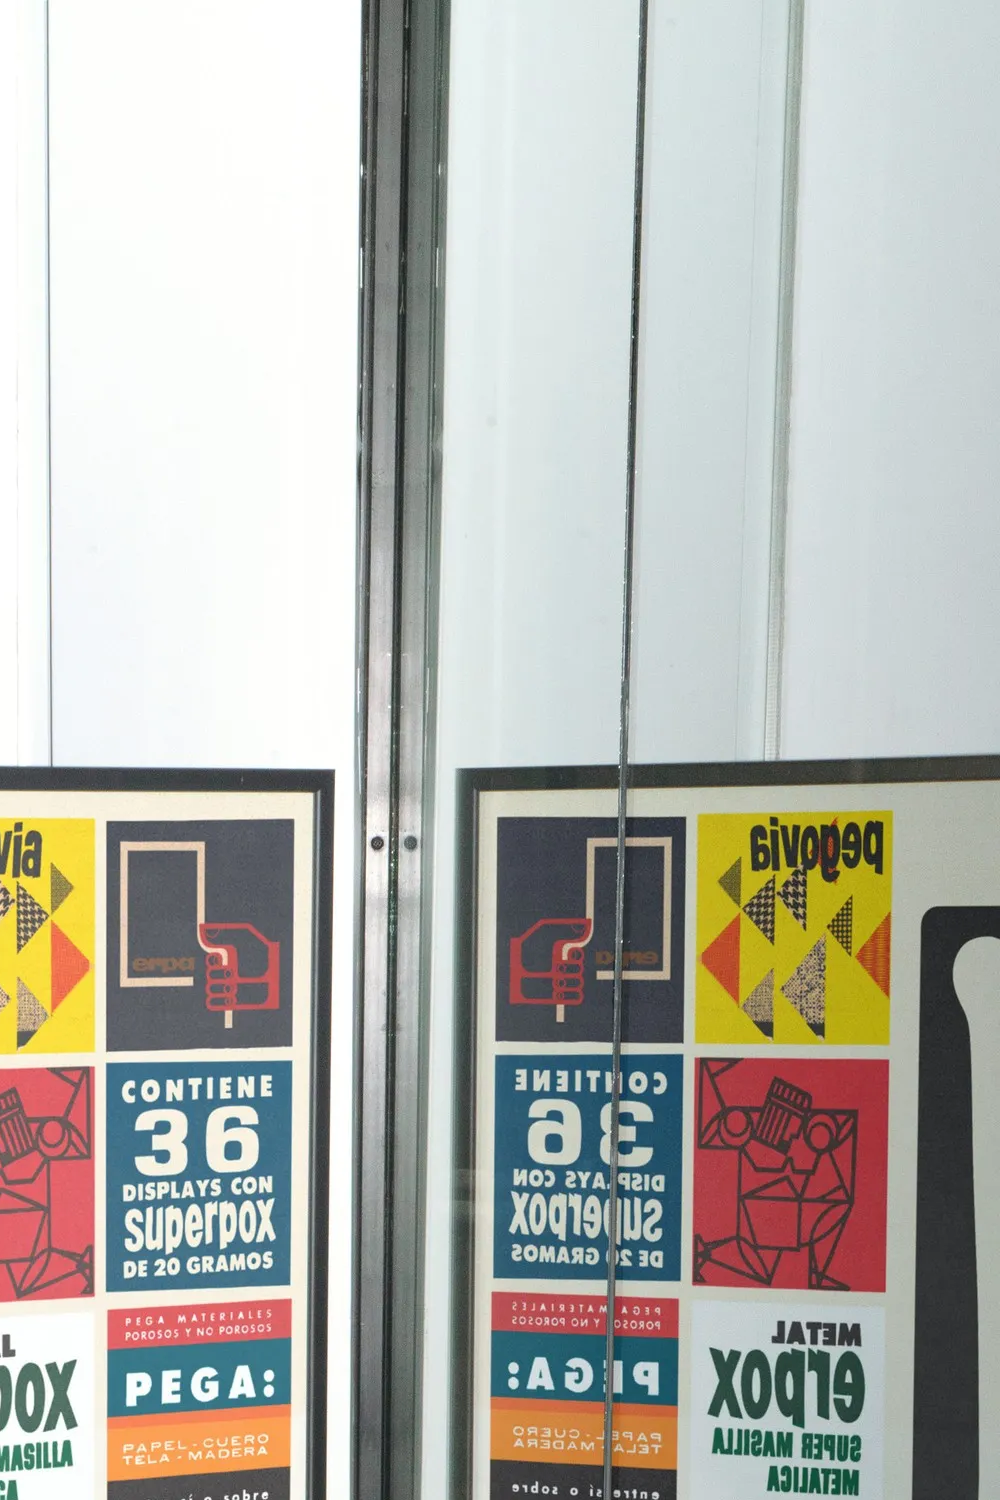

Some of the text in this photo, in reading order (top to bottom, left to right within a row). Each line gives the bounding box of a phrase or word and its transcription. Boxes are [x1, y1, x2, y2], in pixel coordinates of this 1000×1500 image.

[122, 1075, 273, 1103] CONTIENE
[134, 1105, 260, 1176] 36
[123, 1176, 273, 1202] DISPLAYS CON
[124, 1198, 276, 1255] Superpox
[123, 1251, 273, 1279] DE 20 GRAMOS
[125, 1309, 272, 1327] PEGA MATERIALES
[125, 1323, 272, 1341] POROSOS Y NO POROSOS
[125, 1365, 275, 1407] PEGA:
[123, 1434, 269, 1454] PAPEL CUERO
[123, 1446, 268, 1465] TELA MADERA
